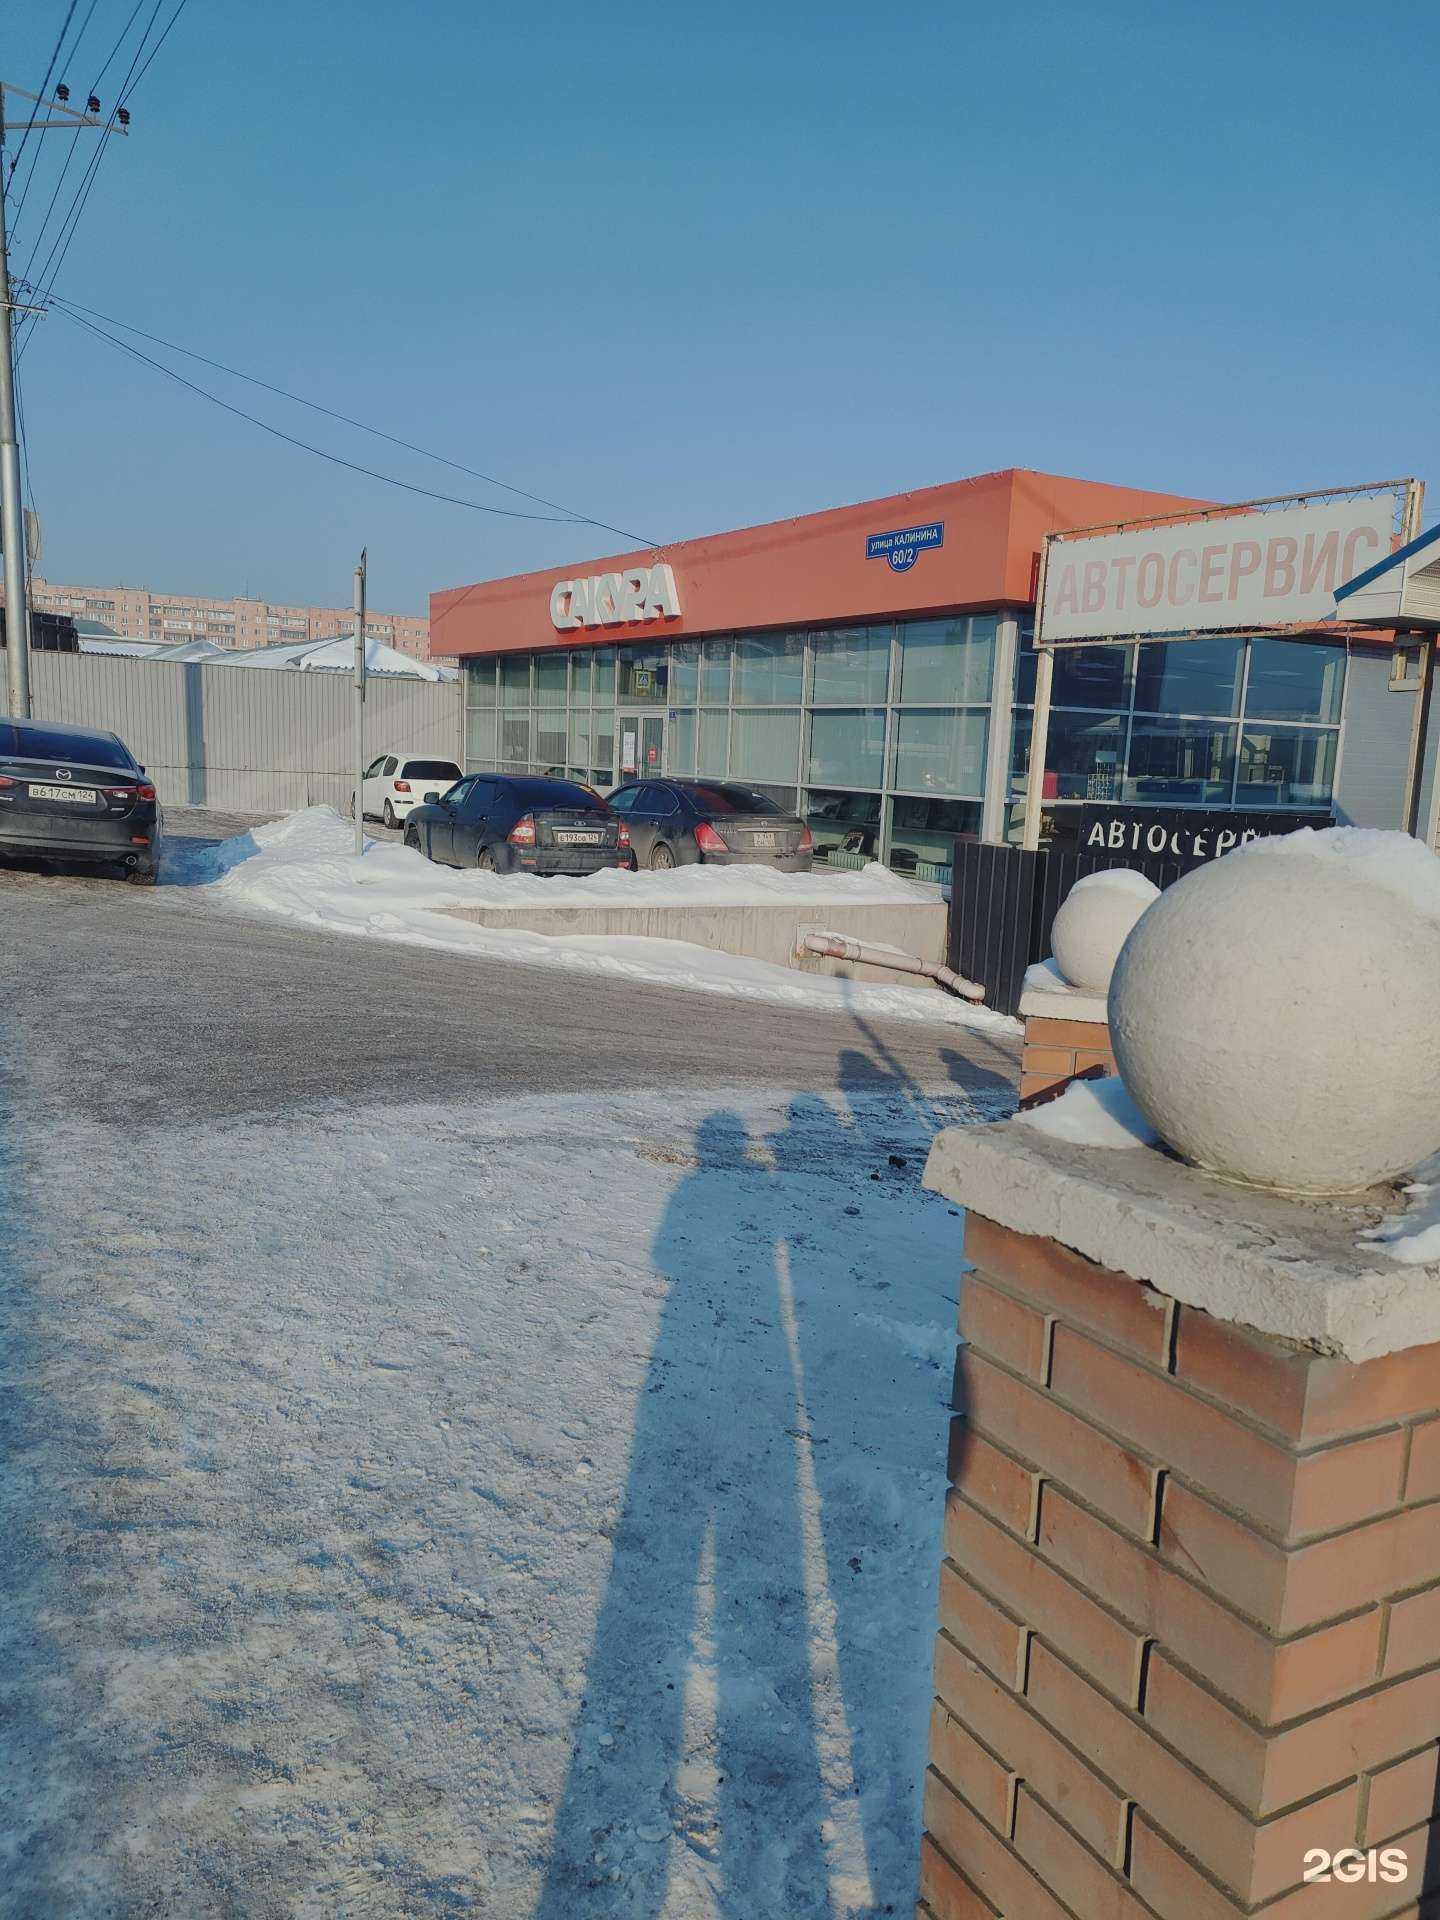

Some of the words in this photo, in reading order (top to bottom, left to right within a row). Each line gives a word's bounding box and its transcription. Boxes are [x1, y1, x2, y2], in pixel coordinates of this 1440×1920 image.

[871, 539, 893, 552] улица
[894, 528, 938, 546] КАЛИНИНА
[892, 548, 914, 565] 60/2
[1053, 526, 1379, 616] АВТОСЕРВИС
[550, 563, 682, 630] САКУРА
